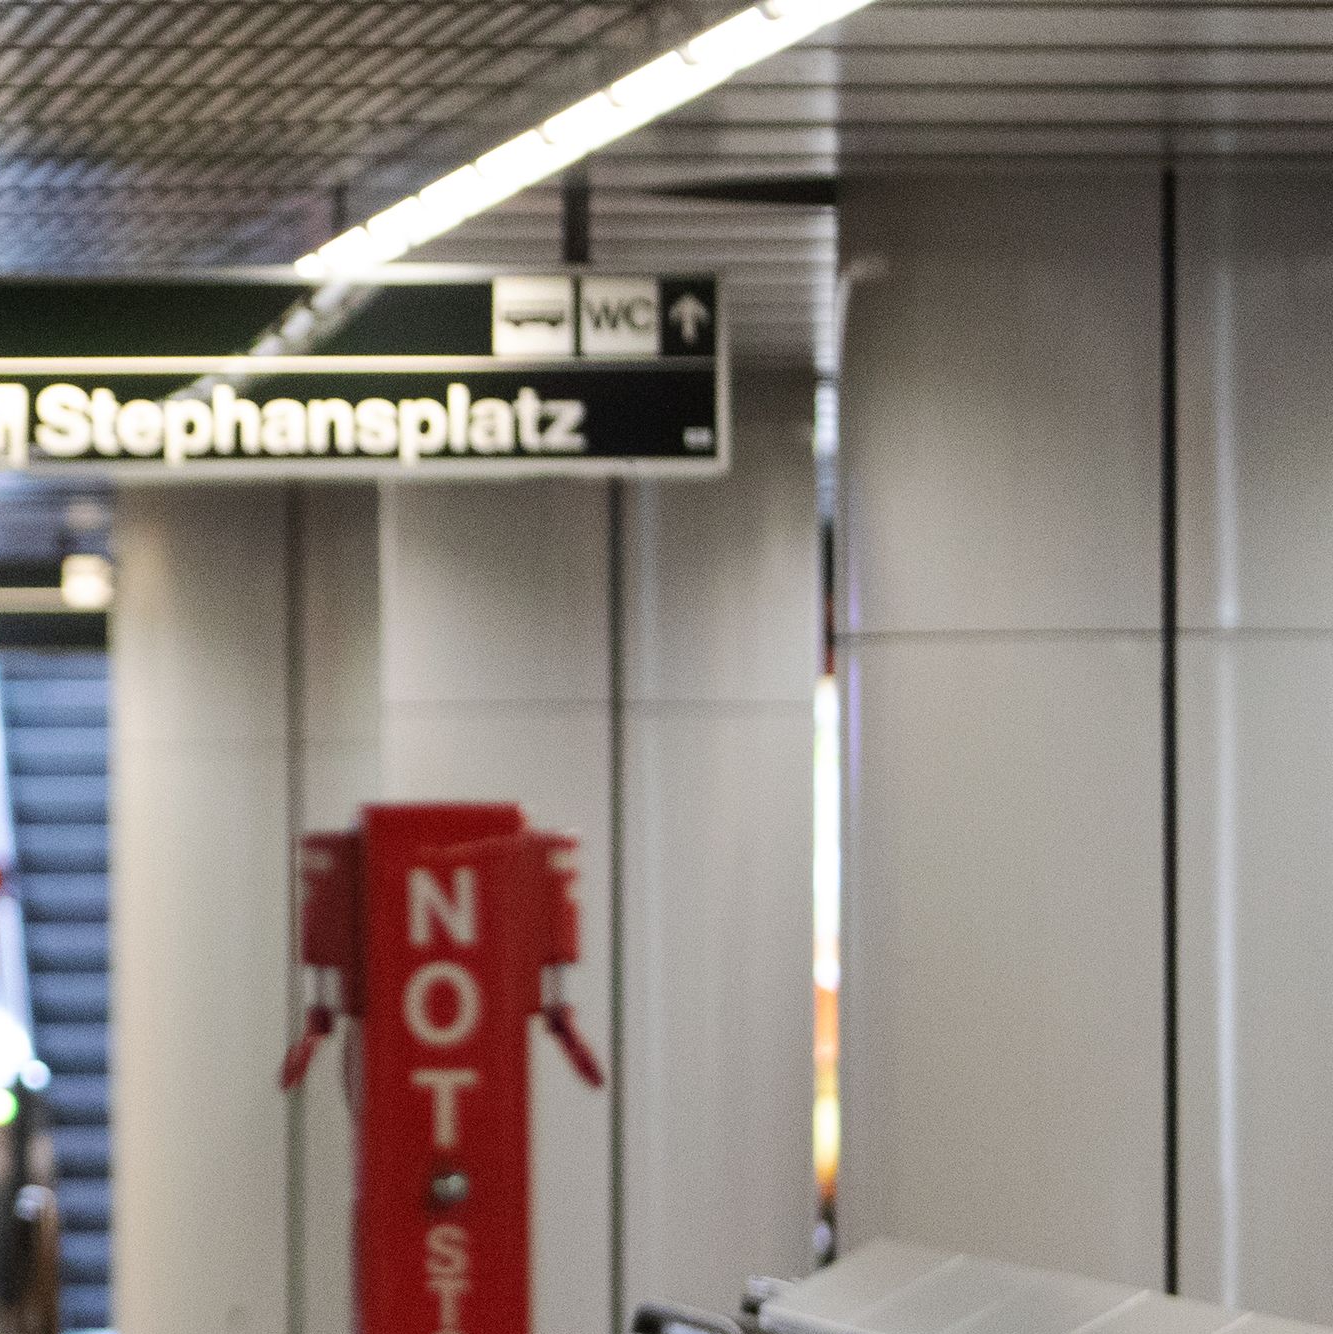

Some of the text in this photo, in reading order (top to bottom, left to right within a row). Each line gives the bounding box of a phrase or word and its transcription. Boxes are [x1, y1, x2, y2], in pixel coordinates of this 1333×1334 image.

[584, 295, 655, 333] WC
[35, 382, 586, 468] Stephansplatz
[403, 867, 482, 1148] NOT
